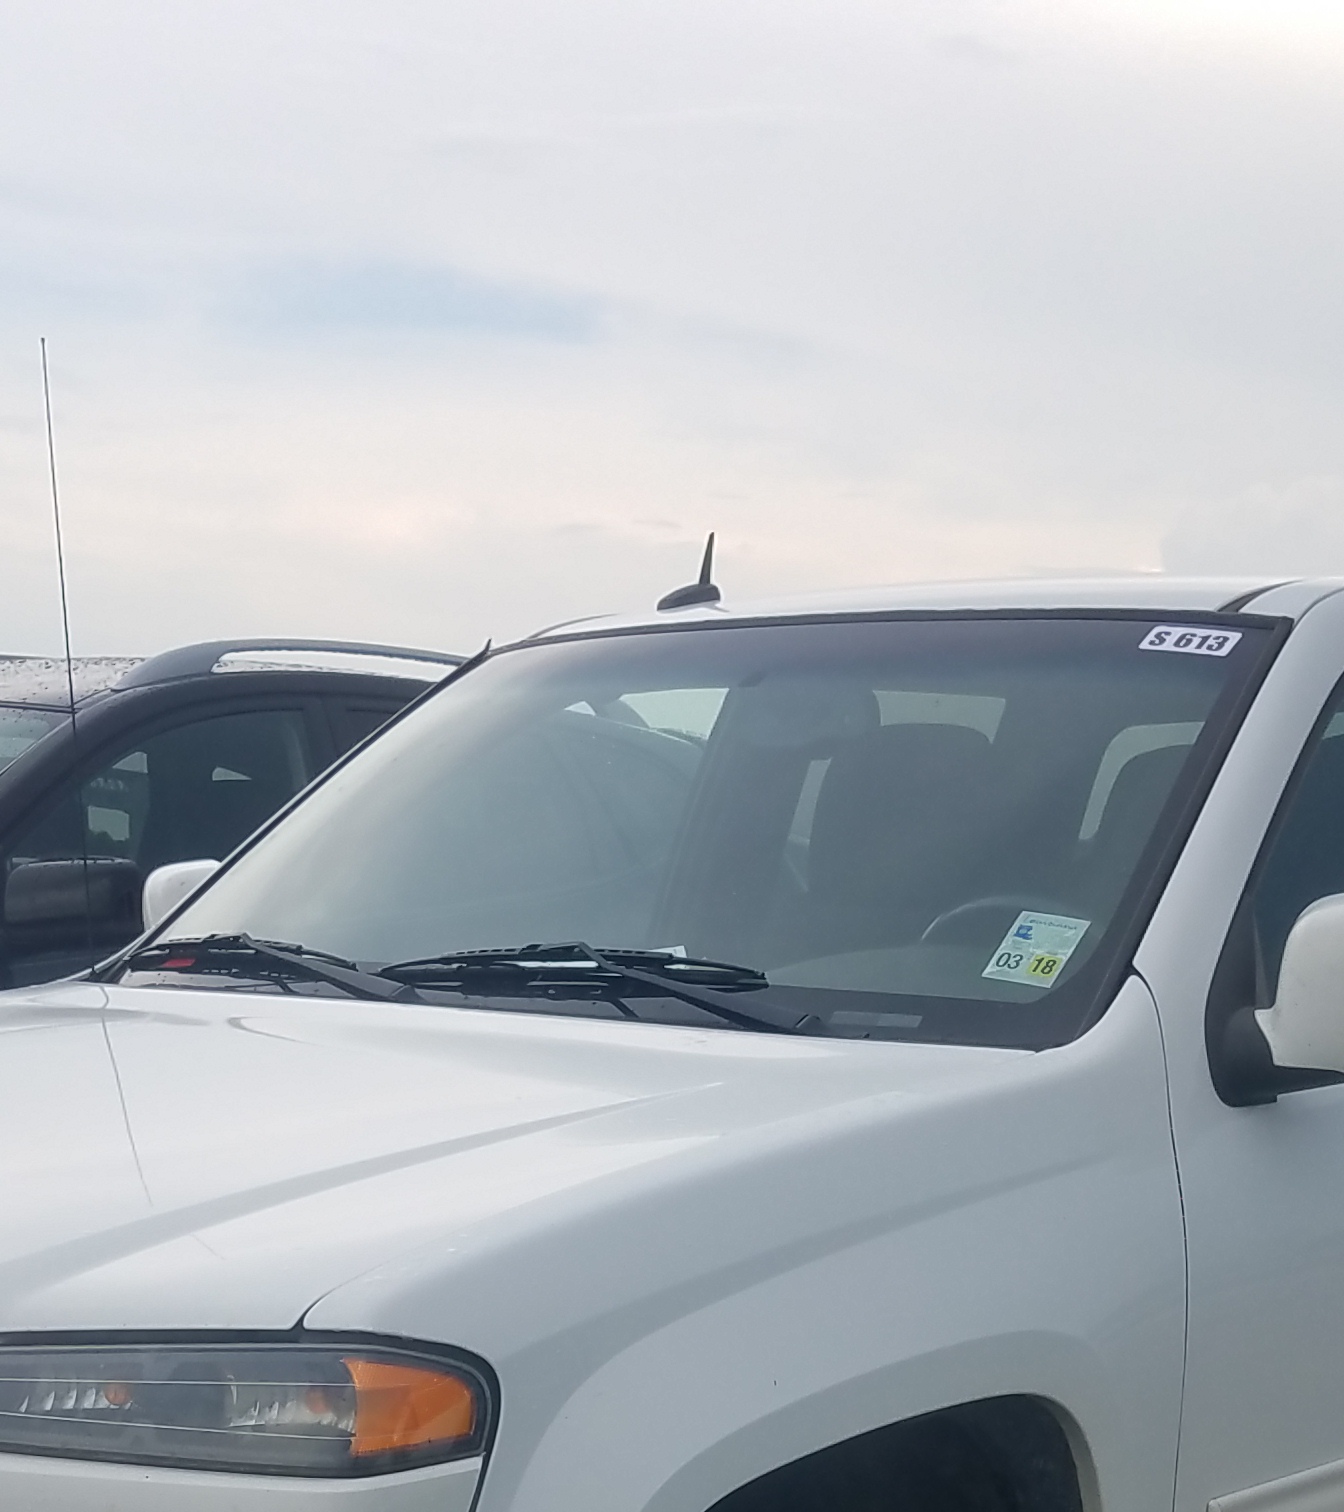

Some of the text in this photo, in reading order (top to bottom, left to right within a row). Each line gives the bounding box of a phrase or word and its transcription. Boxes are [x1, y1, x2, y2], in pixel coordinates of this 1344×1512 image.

[1149, 631, 1230, 651] S 613
[996, 952, 1057, 975] 03 18
